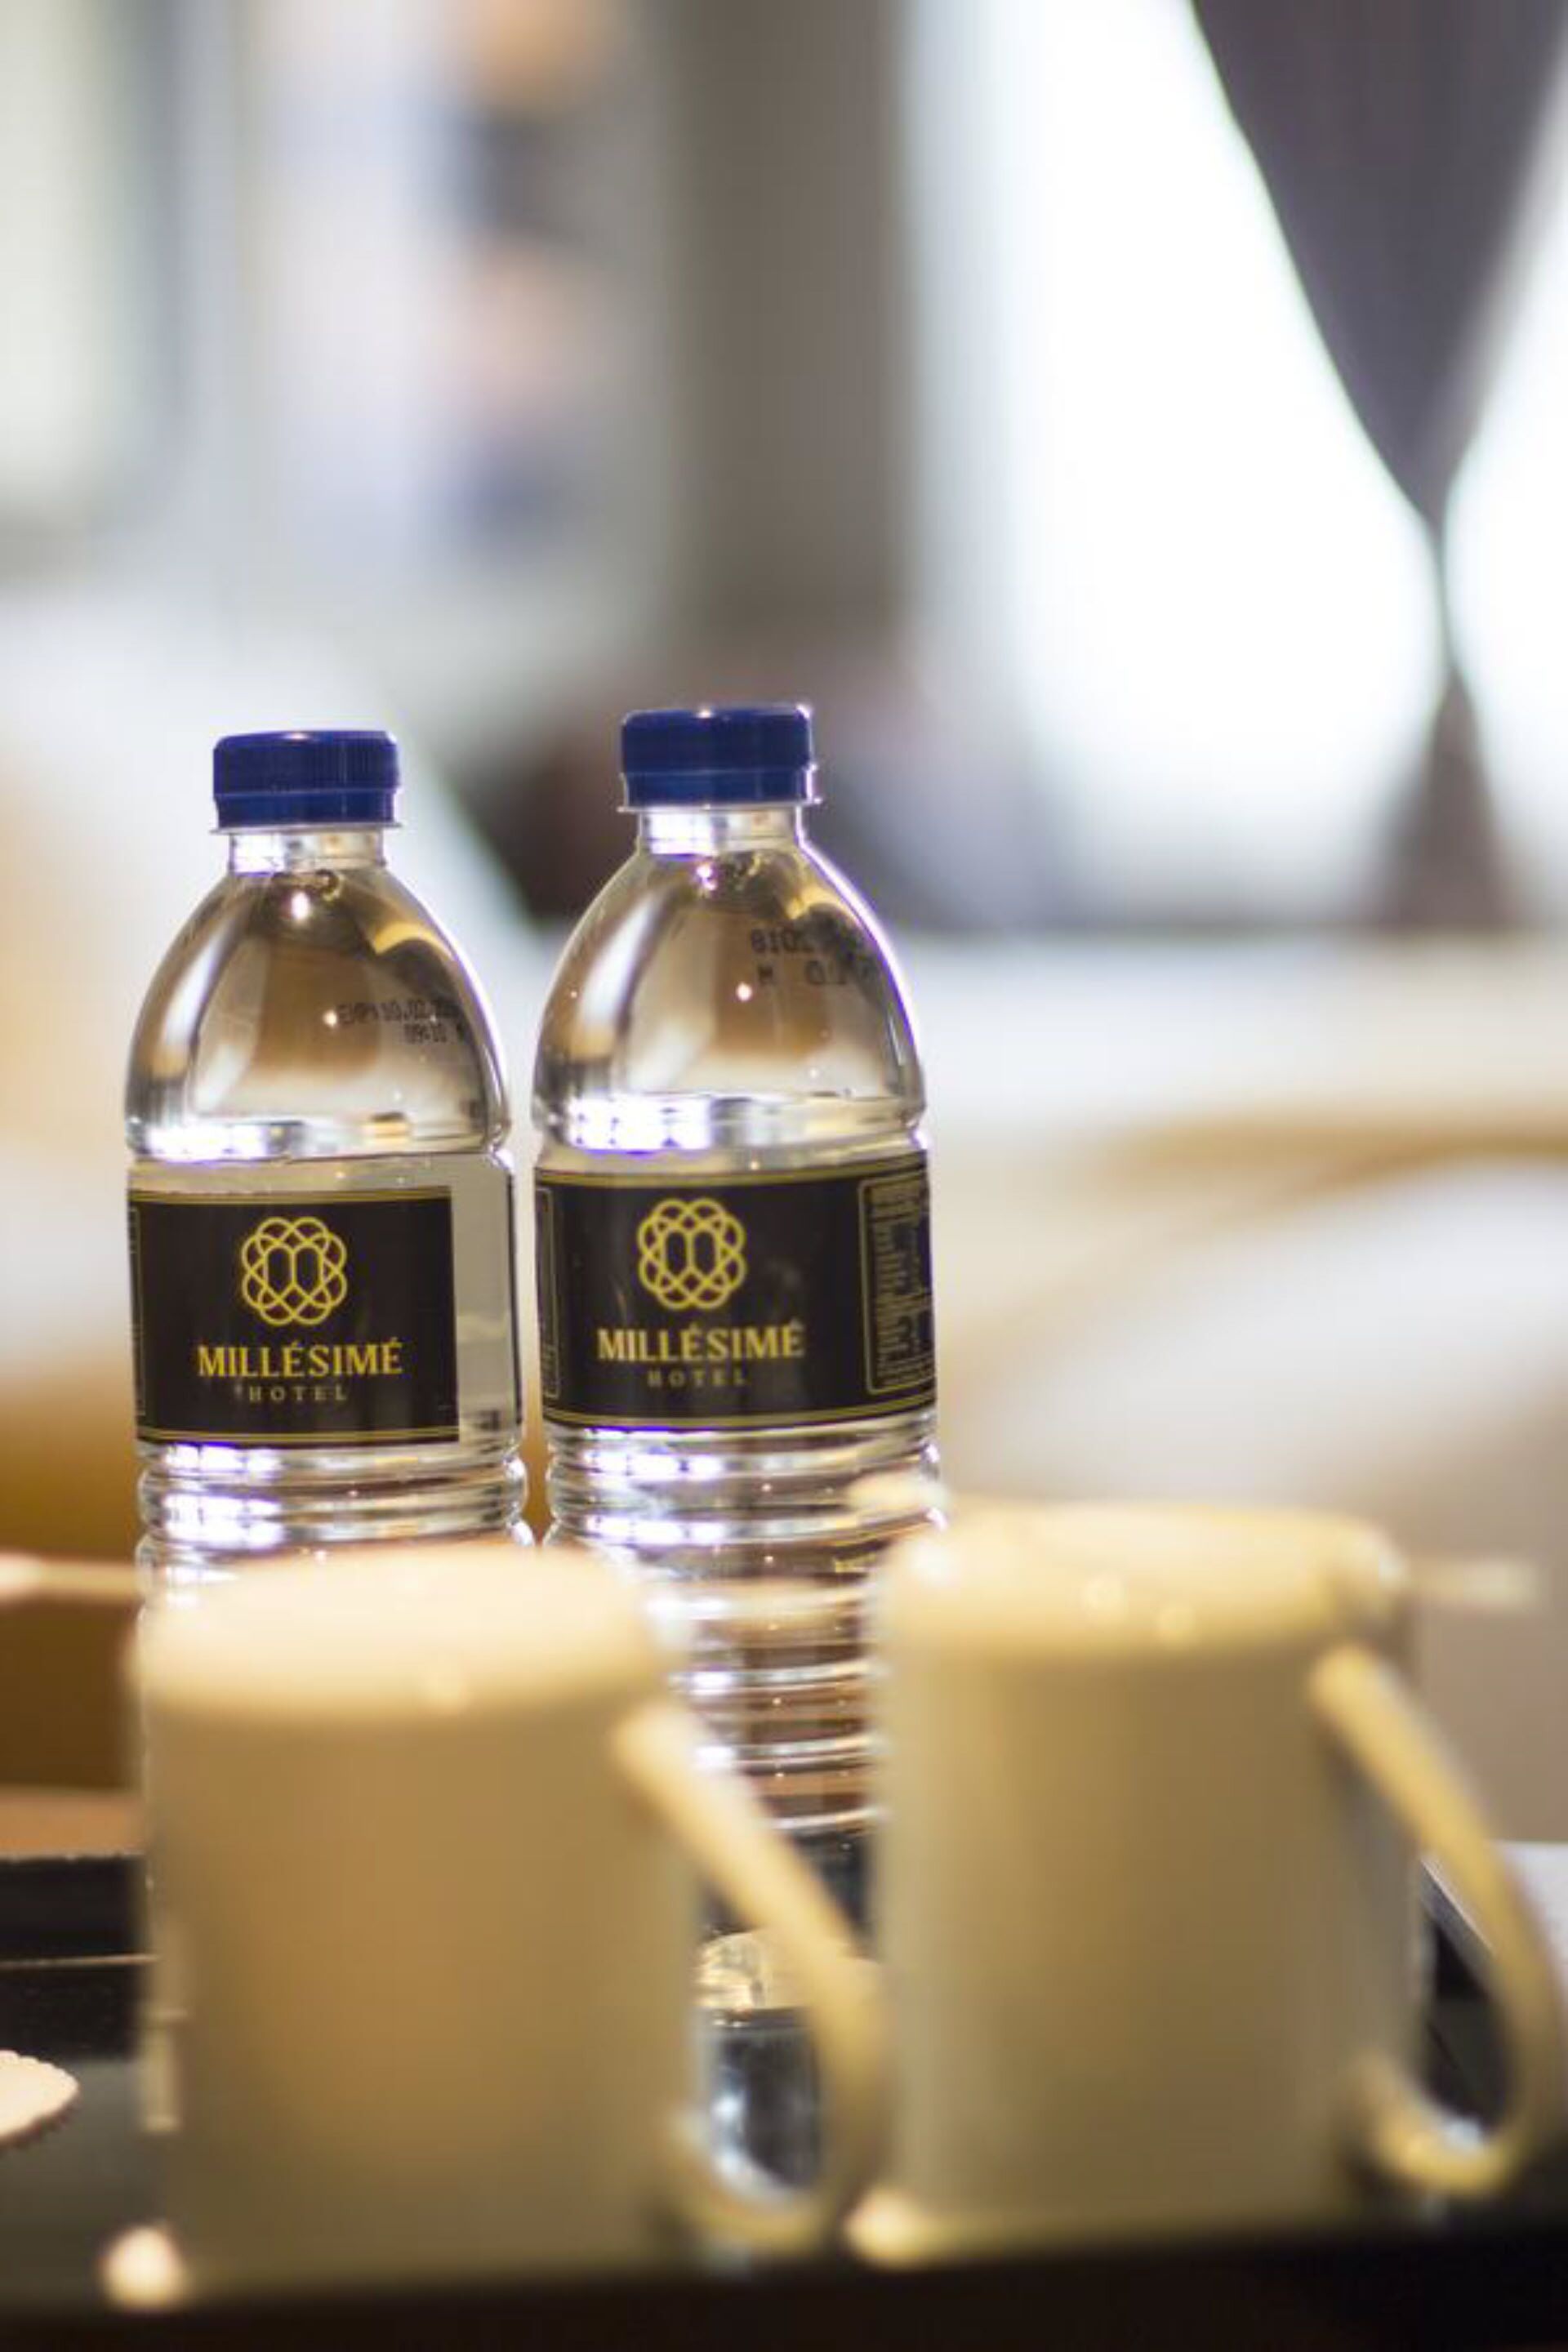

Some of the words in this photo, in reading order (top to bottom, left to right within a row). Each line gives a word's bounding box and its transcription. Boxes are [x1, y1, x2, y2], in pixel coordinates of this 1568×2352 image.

[598, 1317, 805, 1361] MILLÉSIMÉ
[198, 1337, 403, 1378] MILLÉSIMÉ
[248, 1384, 347, 1402] HOTEL
[647, 1367, 746, 1388] HOTEL
